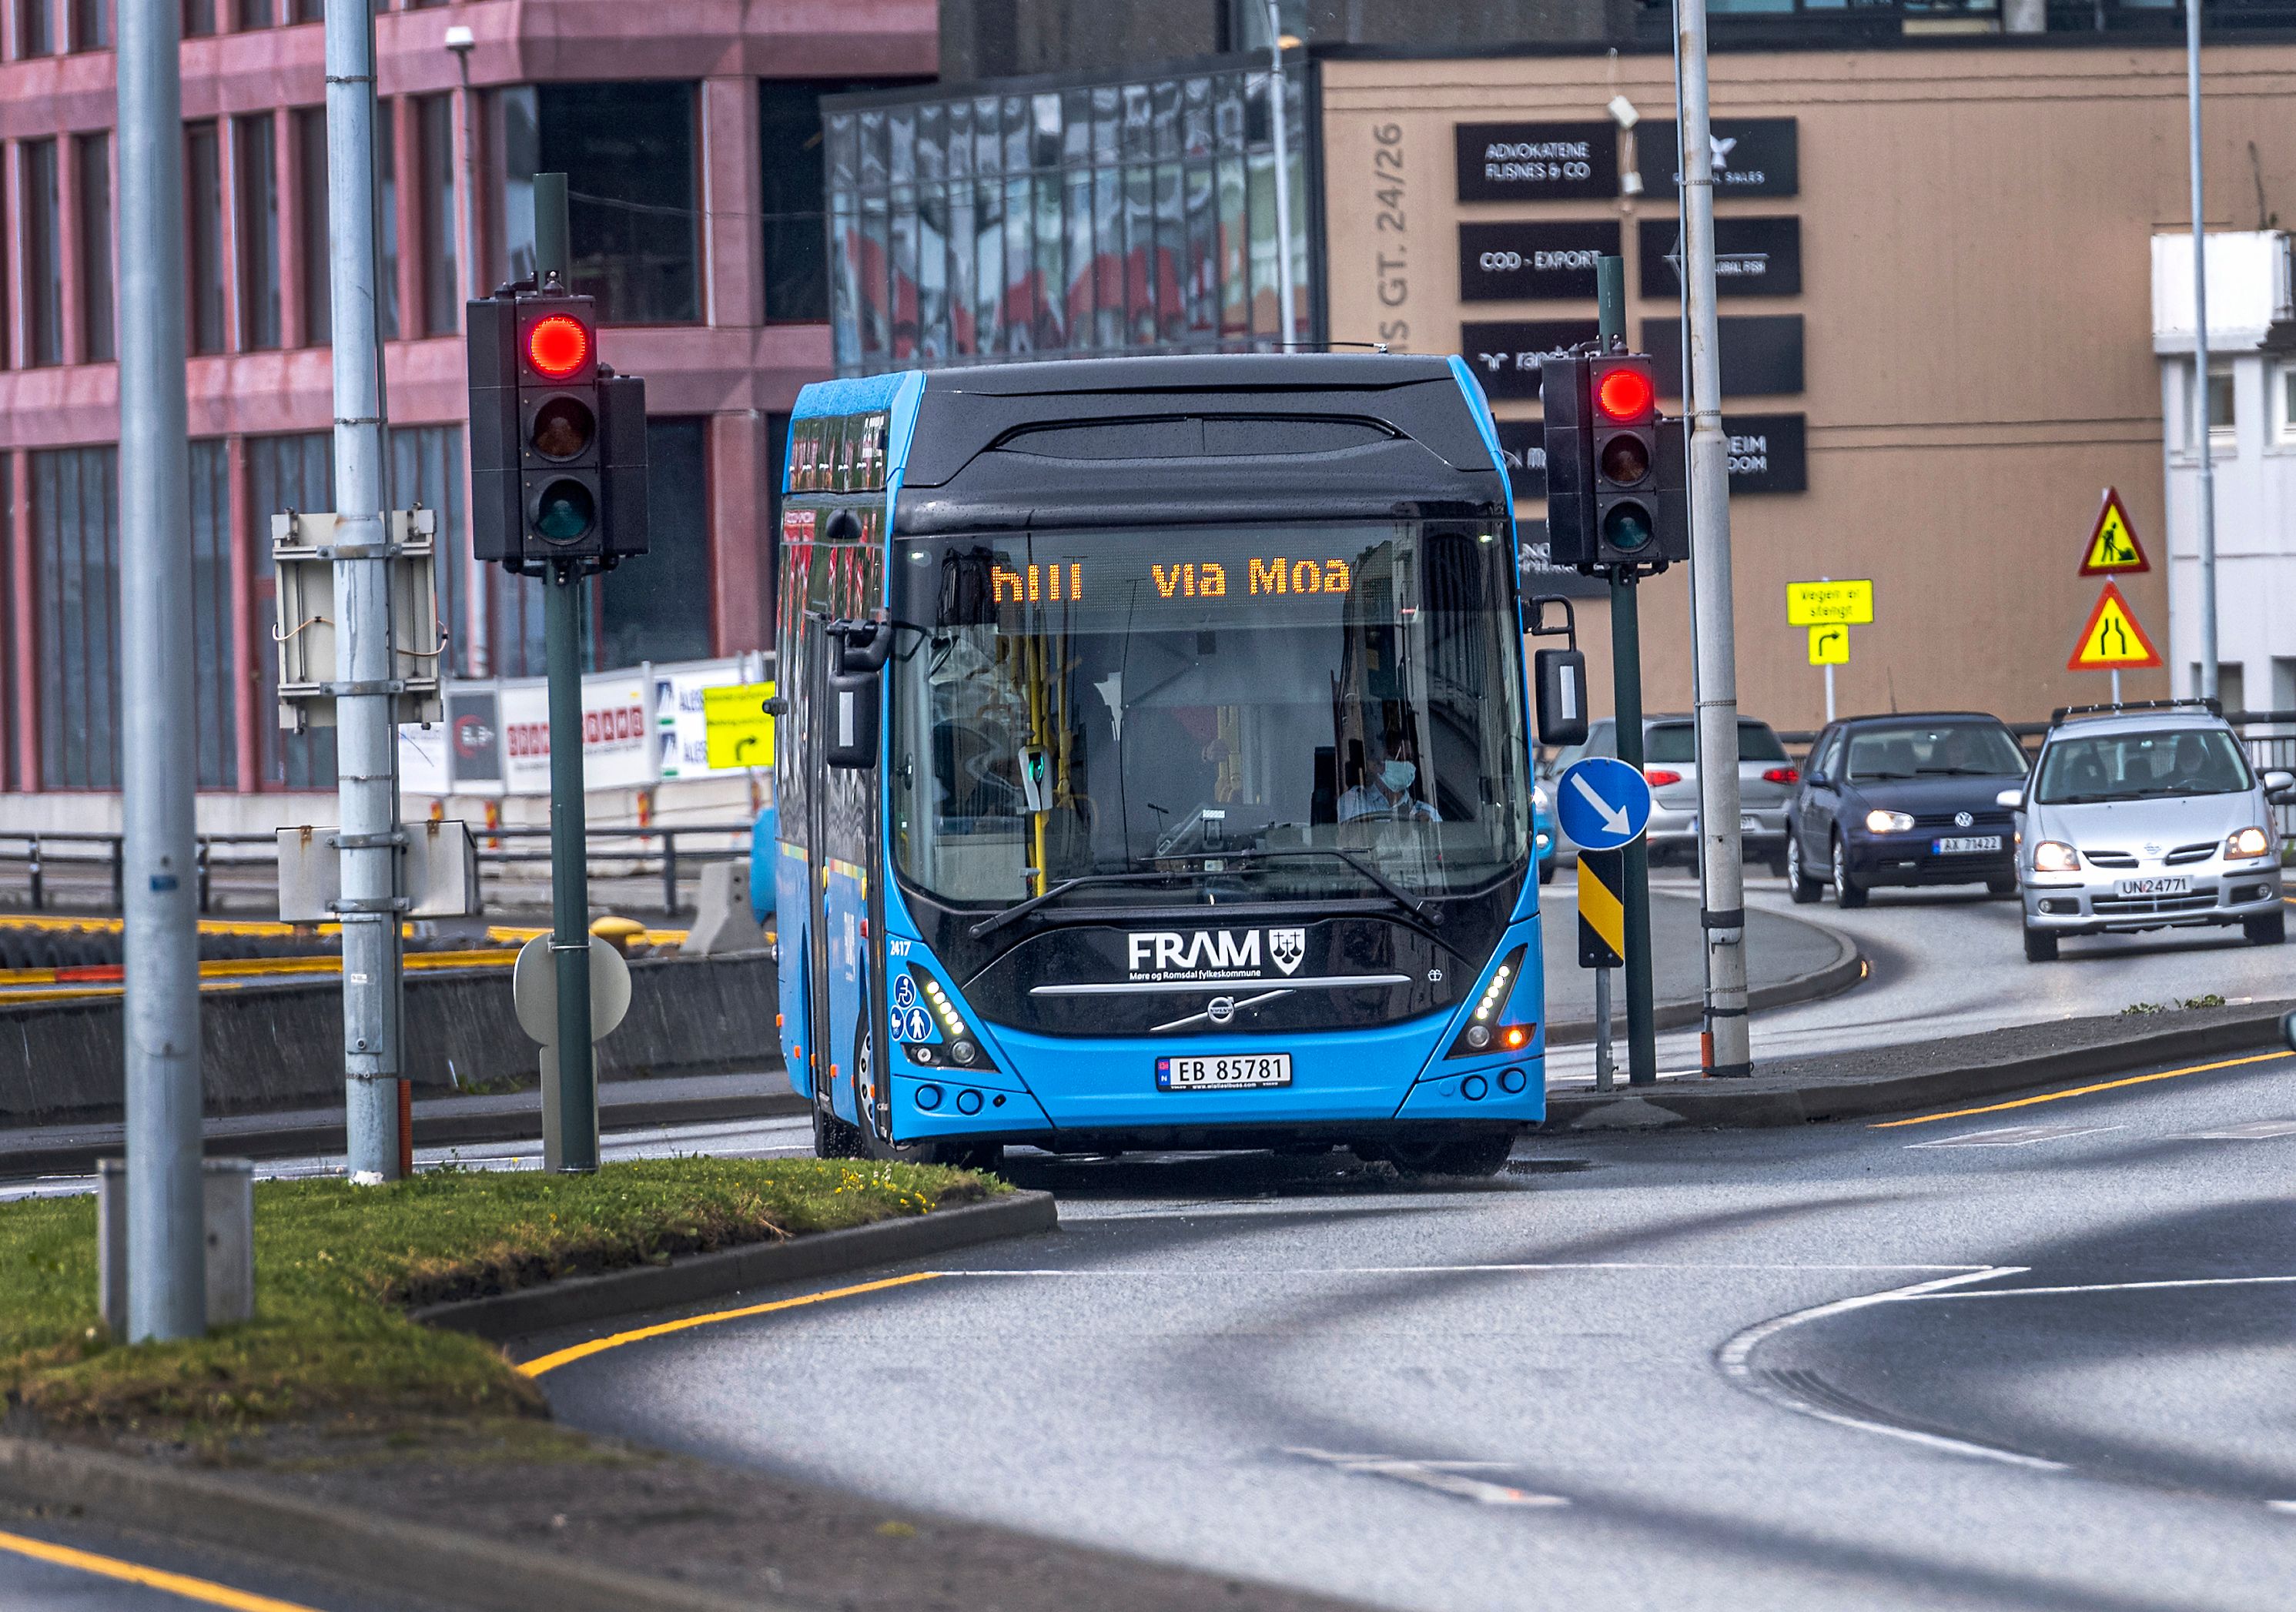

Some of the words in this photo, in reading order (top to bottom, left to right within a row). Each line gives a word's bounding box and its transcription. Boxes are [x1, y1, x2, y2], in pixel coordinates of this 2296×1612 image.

[1484, 142, 1591, 160] ADVOKATENE
[1373, 122, 1406, 232] 24/26
[1563, 162, 1591, 180] CO
[1725, 171, 1765, 184] SALES
[1480, 251, 1521, 270] COD
[1535, 250, 1603, 270] EXPORT
[1151, 563, 1226, 597] via
[1249, 557, 1350, 595] Moa
[2123, 881, 2143, 894] UN
[2145, 878, 2186, 893] 24771
[890, 940, 911, 956] 2417
[1129, 929, 1260, 970] FRAM
[1129, 972, 1150, 980] Møre
[1163, 970, 1197, 979] Romsdal
[1198, 968, 1261, 981] fylkeskommune
[1180, 1061, 1205, 1082] EB
[1217, 1059, 1281, 1080] 85781
